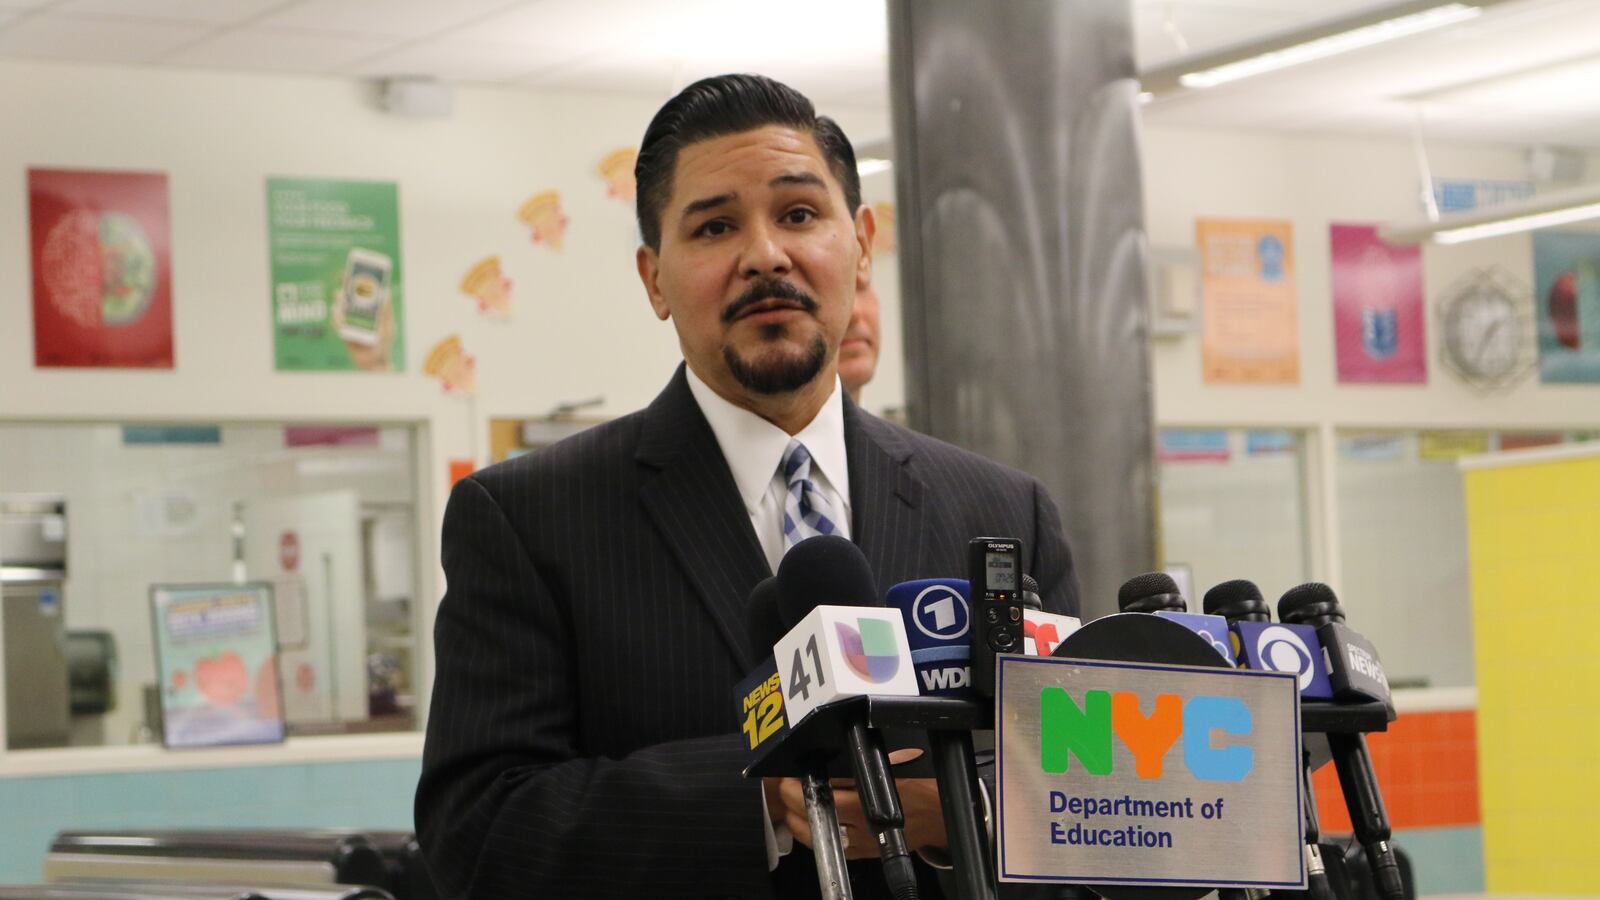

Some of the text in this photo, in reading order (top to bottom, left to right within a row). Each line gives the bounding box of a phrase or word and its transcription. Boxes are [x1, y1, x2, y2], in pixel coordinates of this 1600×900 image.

[789, 633, 825, 701] 41
[743, 672, 780, 713] NEWS
[743, 691, 784, 750] 12
[1040, 687, 1254, 782] NYC
[1049, 790, 1224, 819] Department of
[1051, 822, 1172, 848] Education
